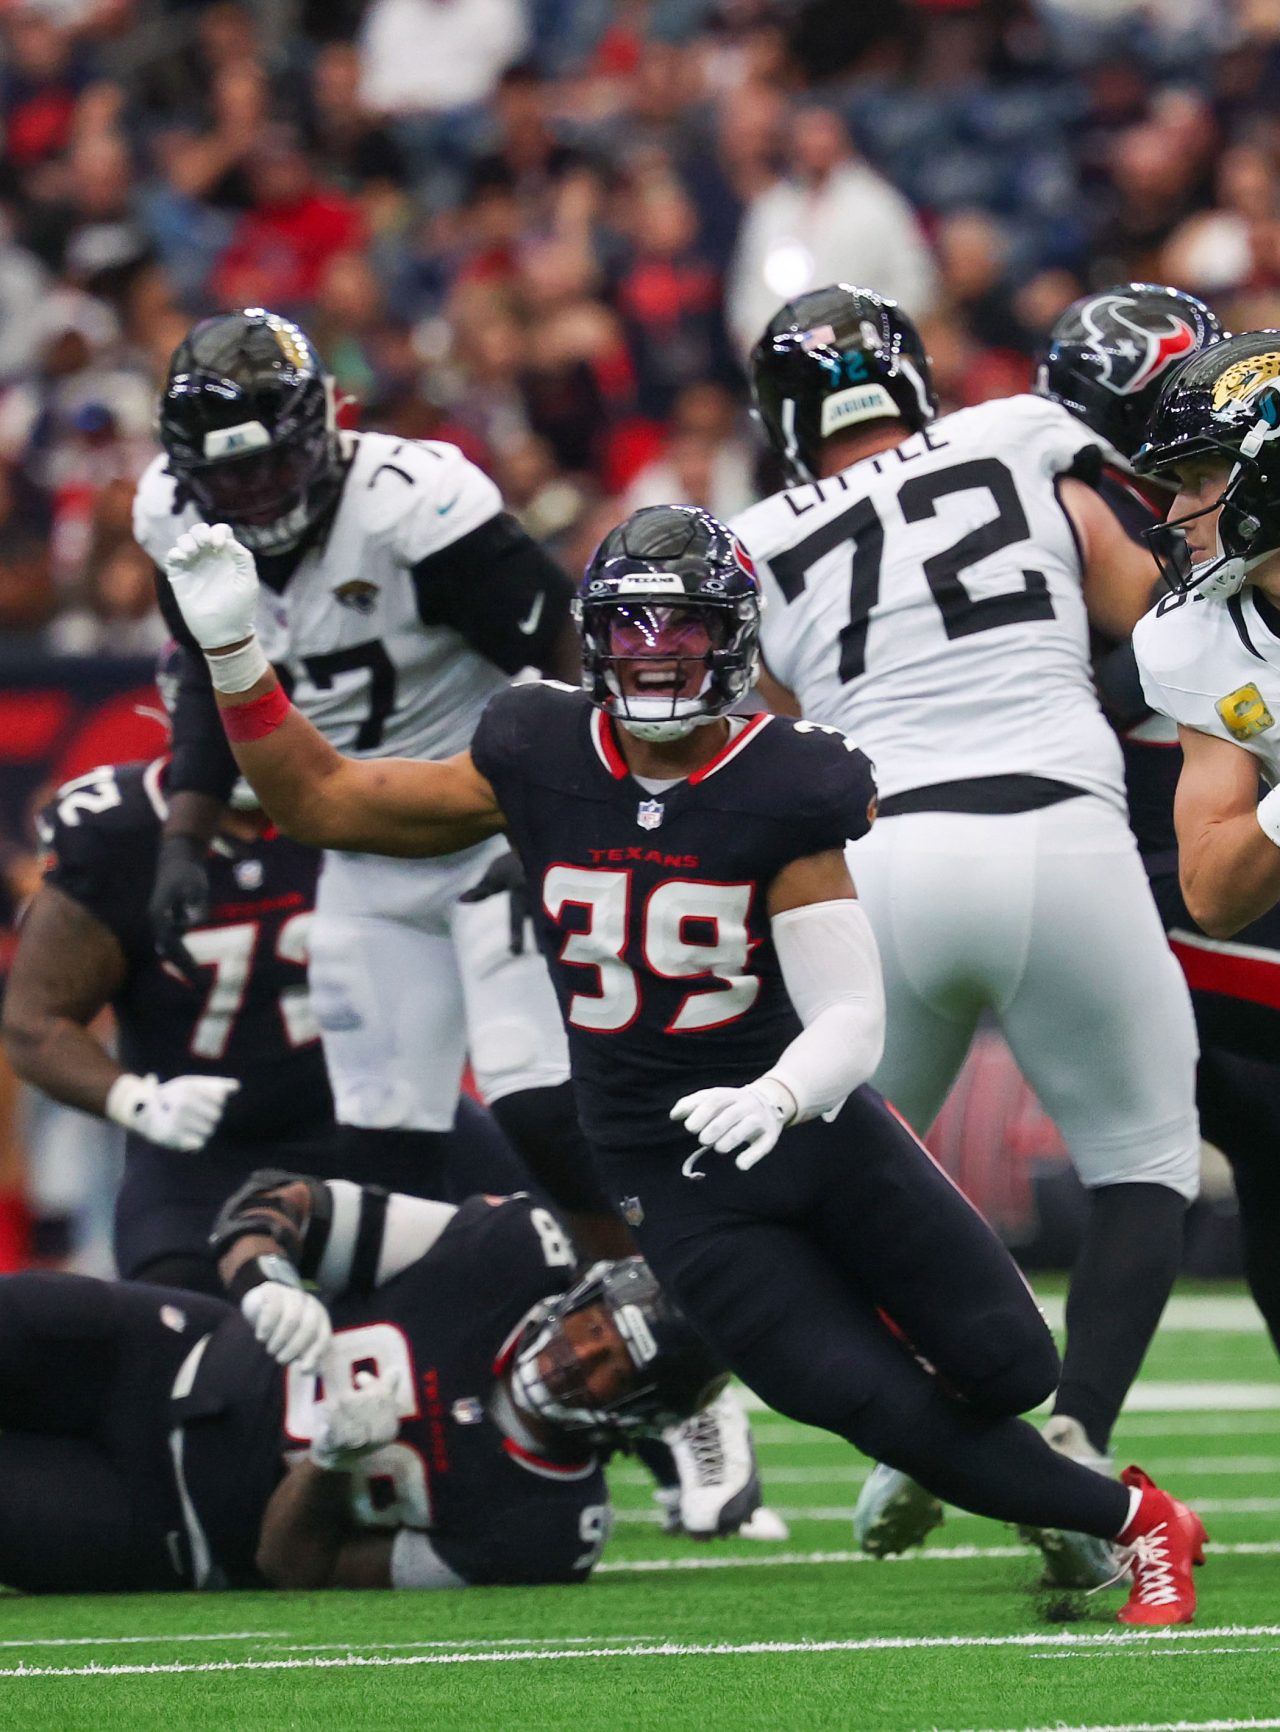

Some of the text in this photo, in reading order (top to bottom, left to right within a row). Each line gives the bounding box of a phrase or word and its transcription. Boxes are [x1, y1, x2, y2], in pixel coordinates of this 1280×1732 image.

[766, 457, 1056, 685] 72
[588, 847, 699, 869] TEXANS
[541, 861, 764, 1034] 39
